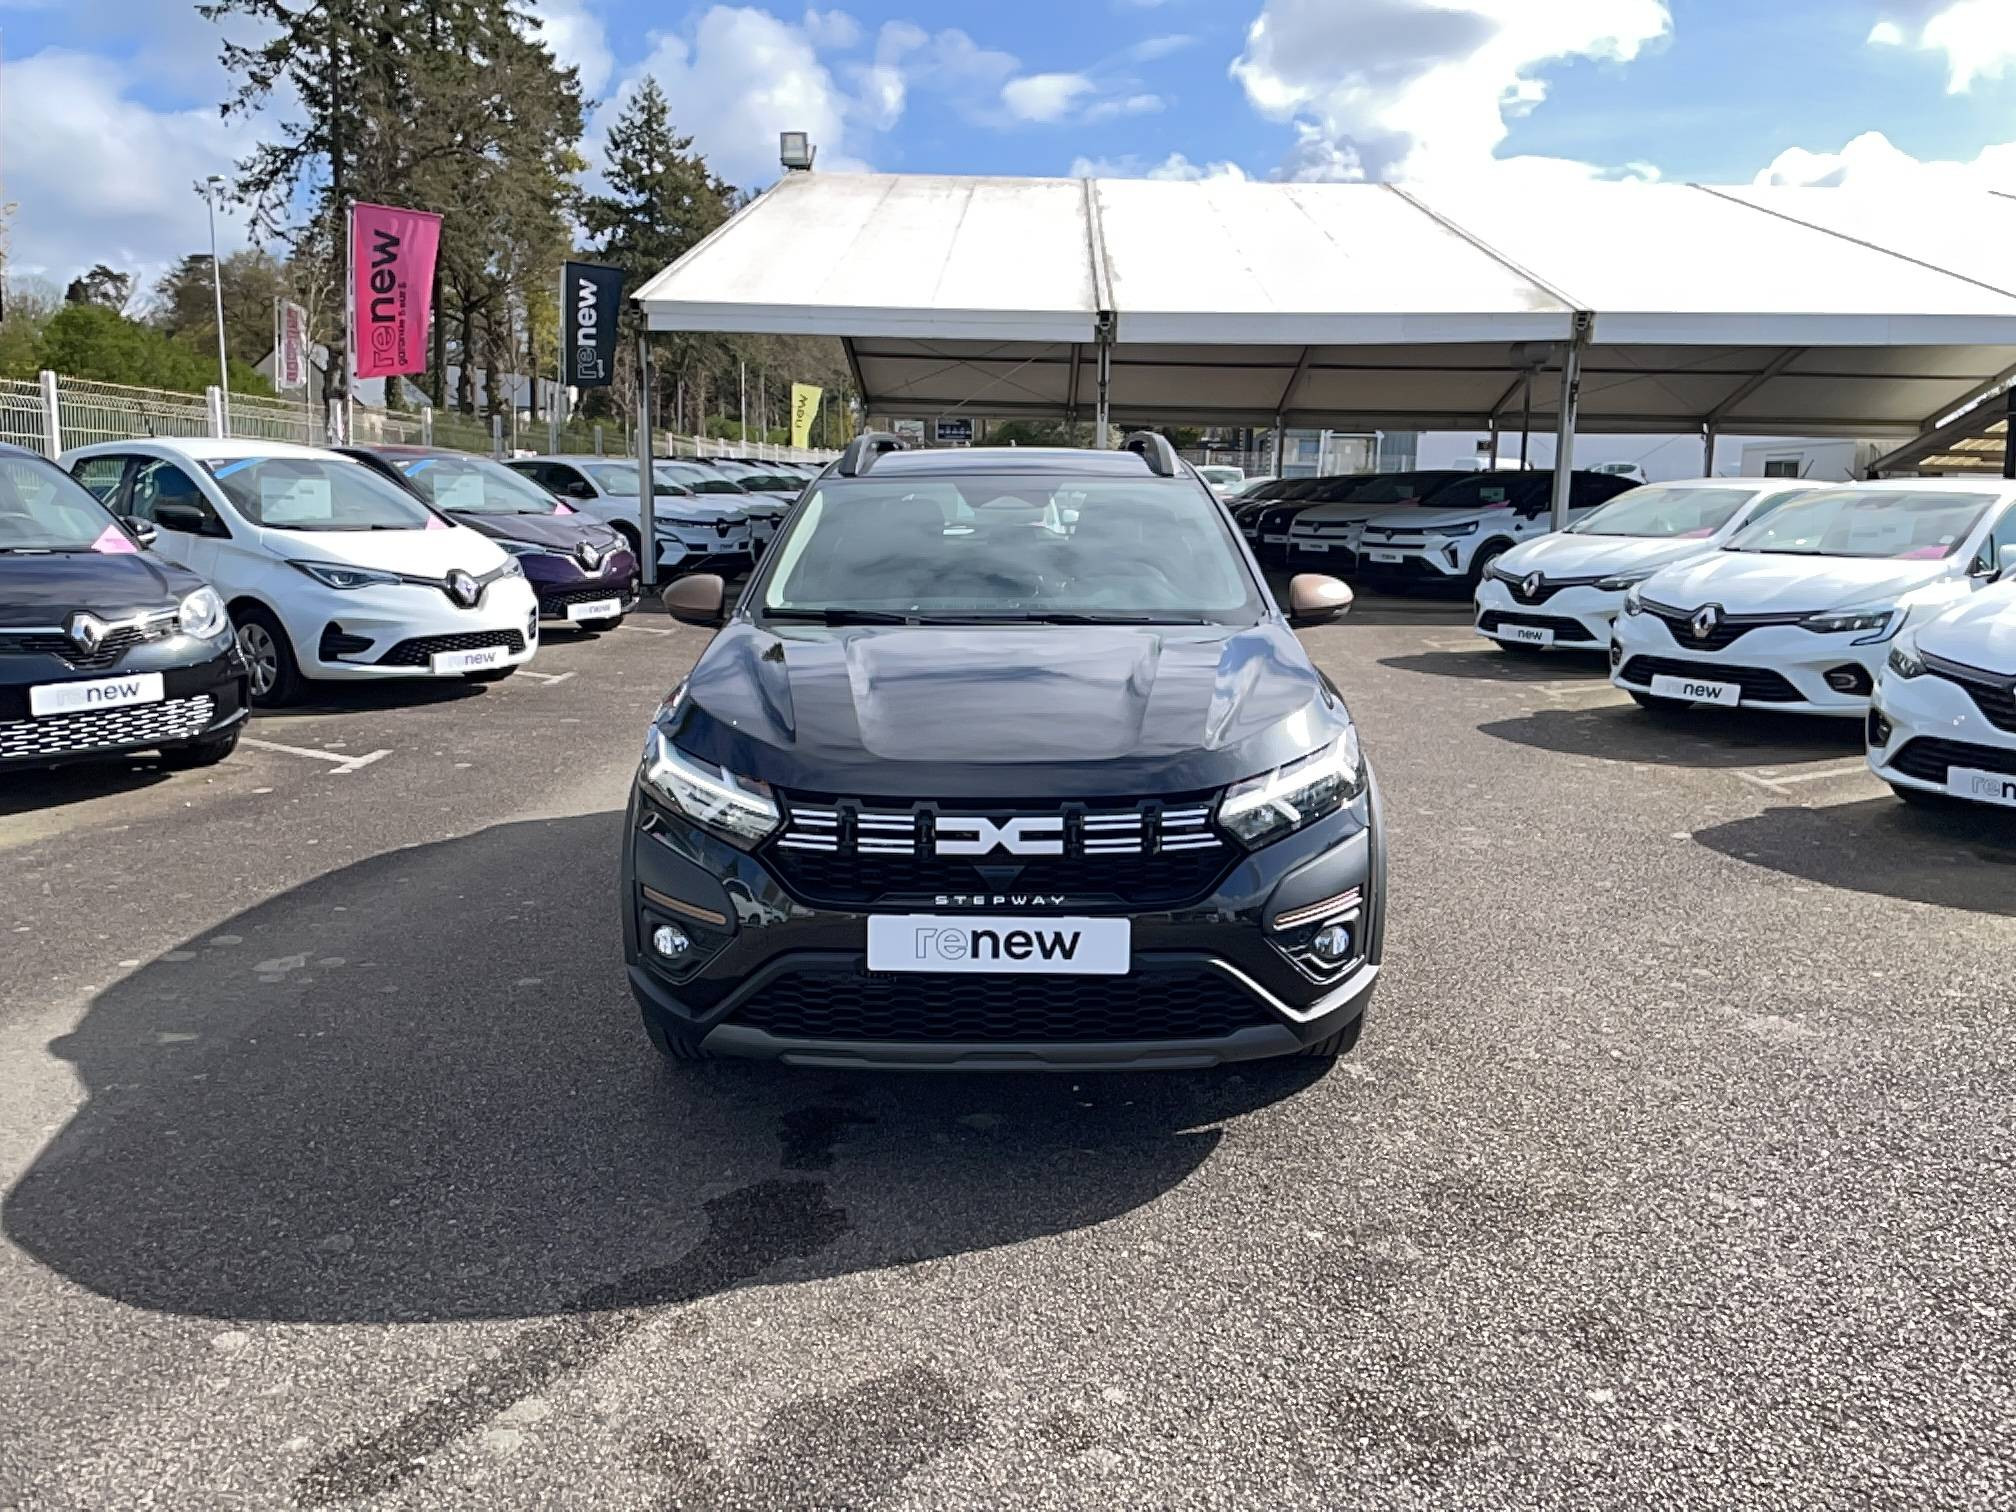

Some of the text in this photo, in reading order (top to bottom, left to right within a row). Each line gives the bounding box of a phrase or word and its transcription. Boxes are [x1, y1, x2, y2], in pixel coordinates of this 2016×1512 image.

[371, 229, 400, 368] renew
[577, 278, 598, 379] renew
[1505, 628, 1543, 640] new
[447, 652, 496, 668] new
[1666, 682, 1723, 699] new
[934, 895, 1065, 905] STEPWAY
[915, 927, 1082, 961] renew
